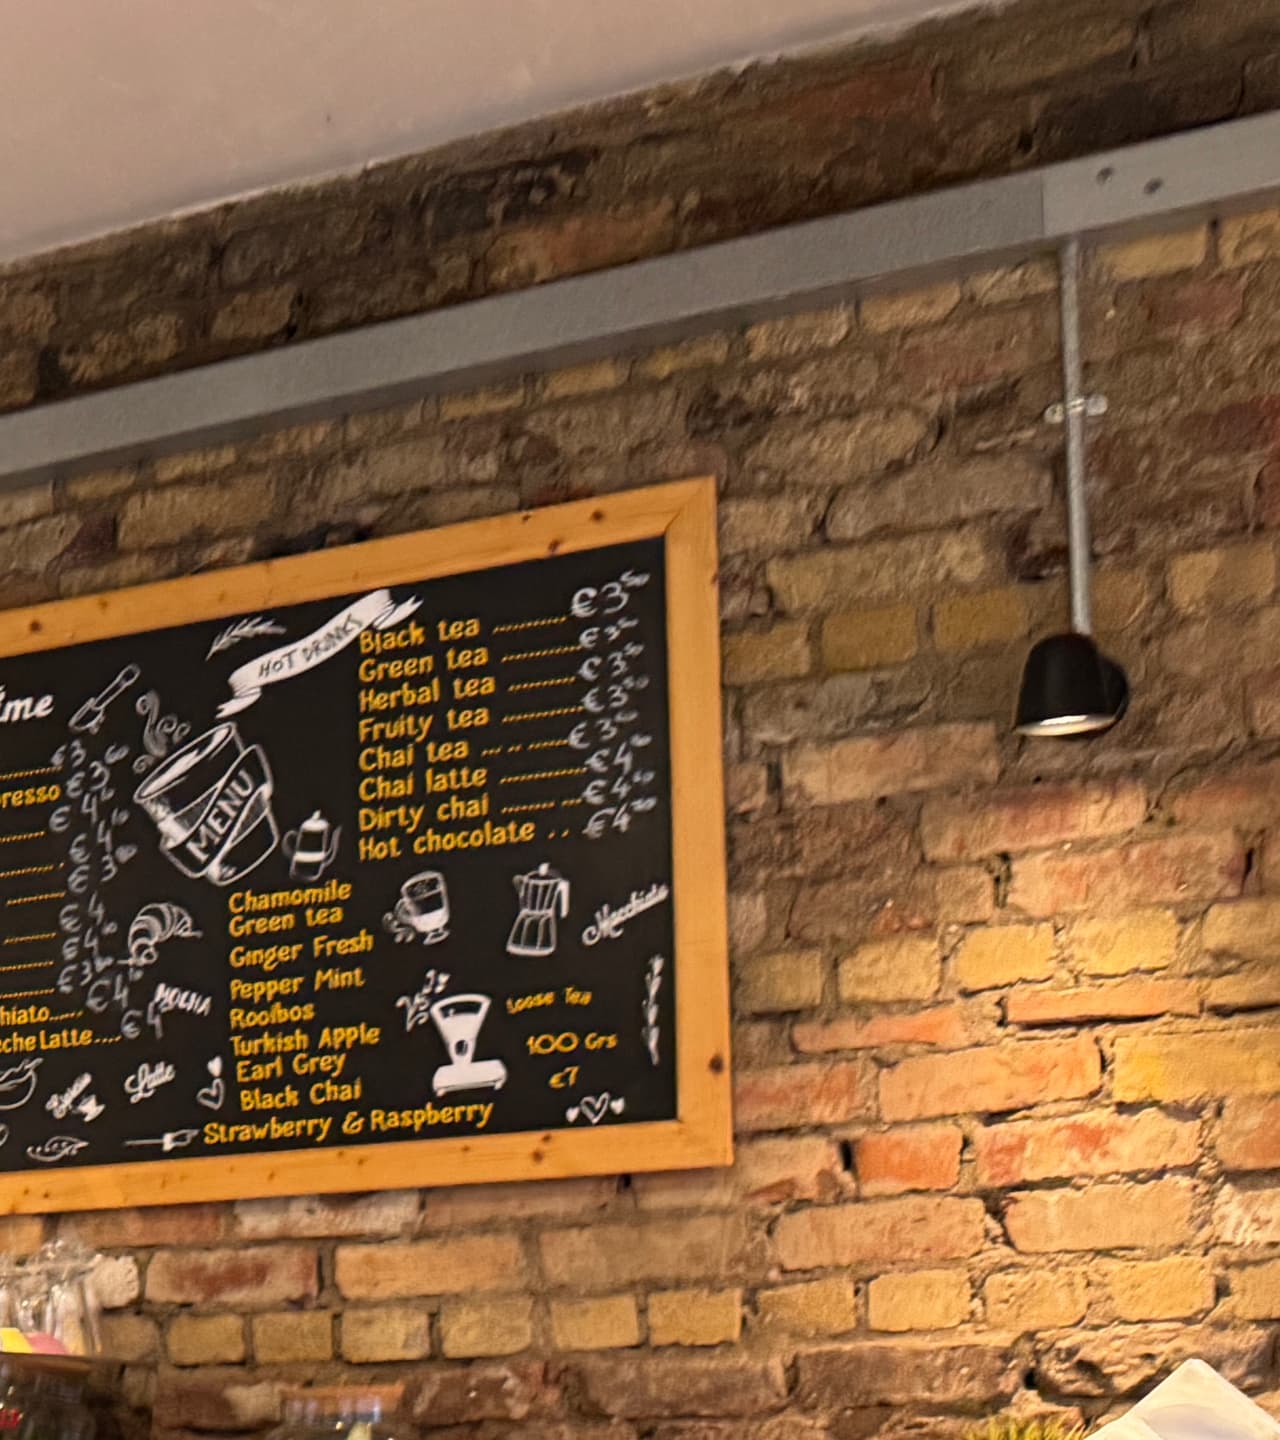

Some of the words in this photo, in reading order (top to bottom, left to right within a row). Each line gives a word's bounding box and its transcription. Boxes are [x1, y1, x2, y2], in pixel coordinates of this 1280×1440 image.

[360, 620, 426, 655] Black
[438, 617, 481, 640] tea
[257, 656, 297, 678] HOT
[359, 656, 434, 684] Green
[446, 646, 490, 670] tea
[359, 679, 440, 713] Herbal
[452, 674, 496, 699] tea
[359, 714, 433, 743] Fruity
[446, 705, 490, 729] tea
[359, 743, 416, 773] Chai
[426, 737, 470, 761] tea
[359, 772, 416, 802] Chai
[425, 764, 488, 790] latte
[188, 771, 256, 864] MENU
[359, 804, 420, 836] Dirty
[436, 793, 490, 821] chai
[359, 834, 402, 861] Hot
[415, 818, 536, 855] chocolate
[228, 879, 352, 915] Chamomile
[228, 914, 295, 939] Green
[305, 905, 344, 928] tea
[229, 943, 303, 972] Ginger
[313, 929, 375, 959] Fresh
[153, 982, 213, 1017] MOCHA
[229, 974, 305, 1002] Pepper
[314, 966, 365, 992] Mint
[229, 1004, 316, 1030] Rooibos
[39, 1026, 94, 1051] Latte
[229, 1032, 309, 1060] Turkish
[318, 1021, 382, 1049] Apple
[526, 1031, 580, 1055] 100
[236, 1059, 289, 1084] Earl
[291, 1050, 348, 1079] Grey
[239, 1086, 300, 1112] Black
[308, 1076, 363, 1103] Chai
[203, 1112, 333, 1145] Strawberry
[341, 1111, 366, 1134] &
[369, 1101, 496, 1134] Raspberry
